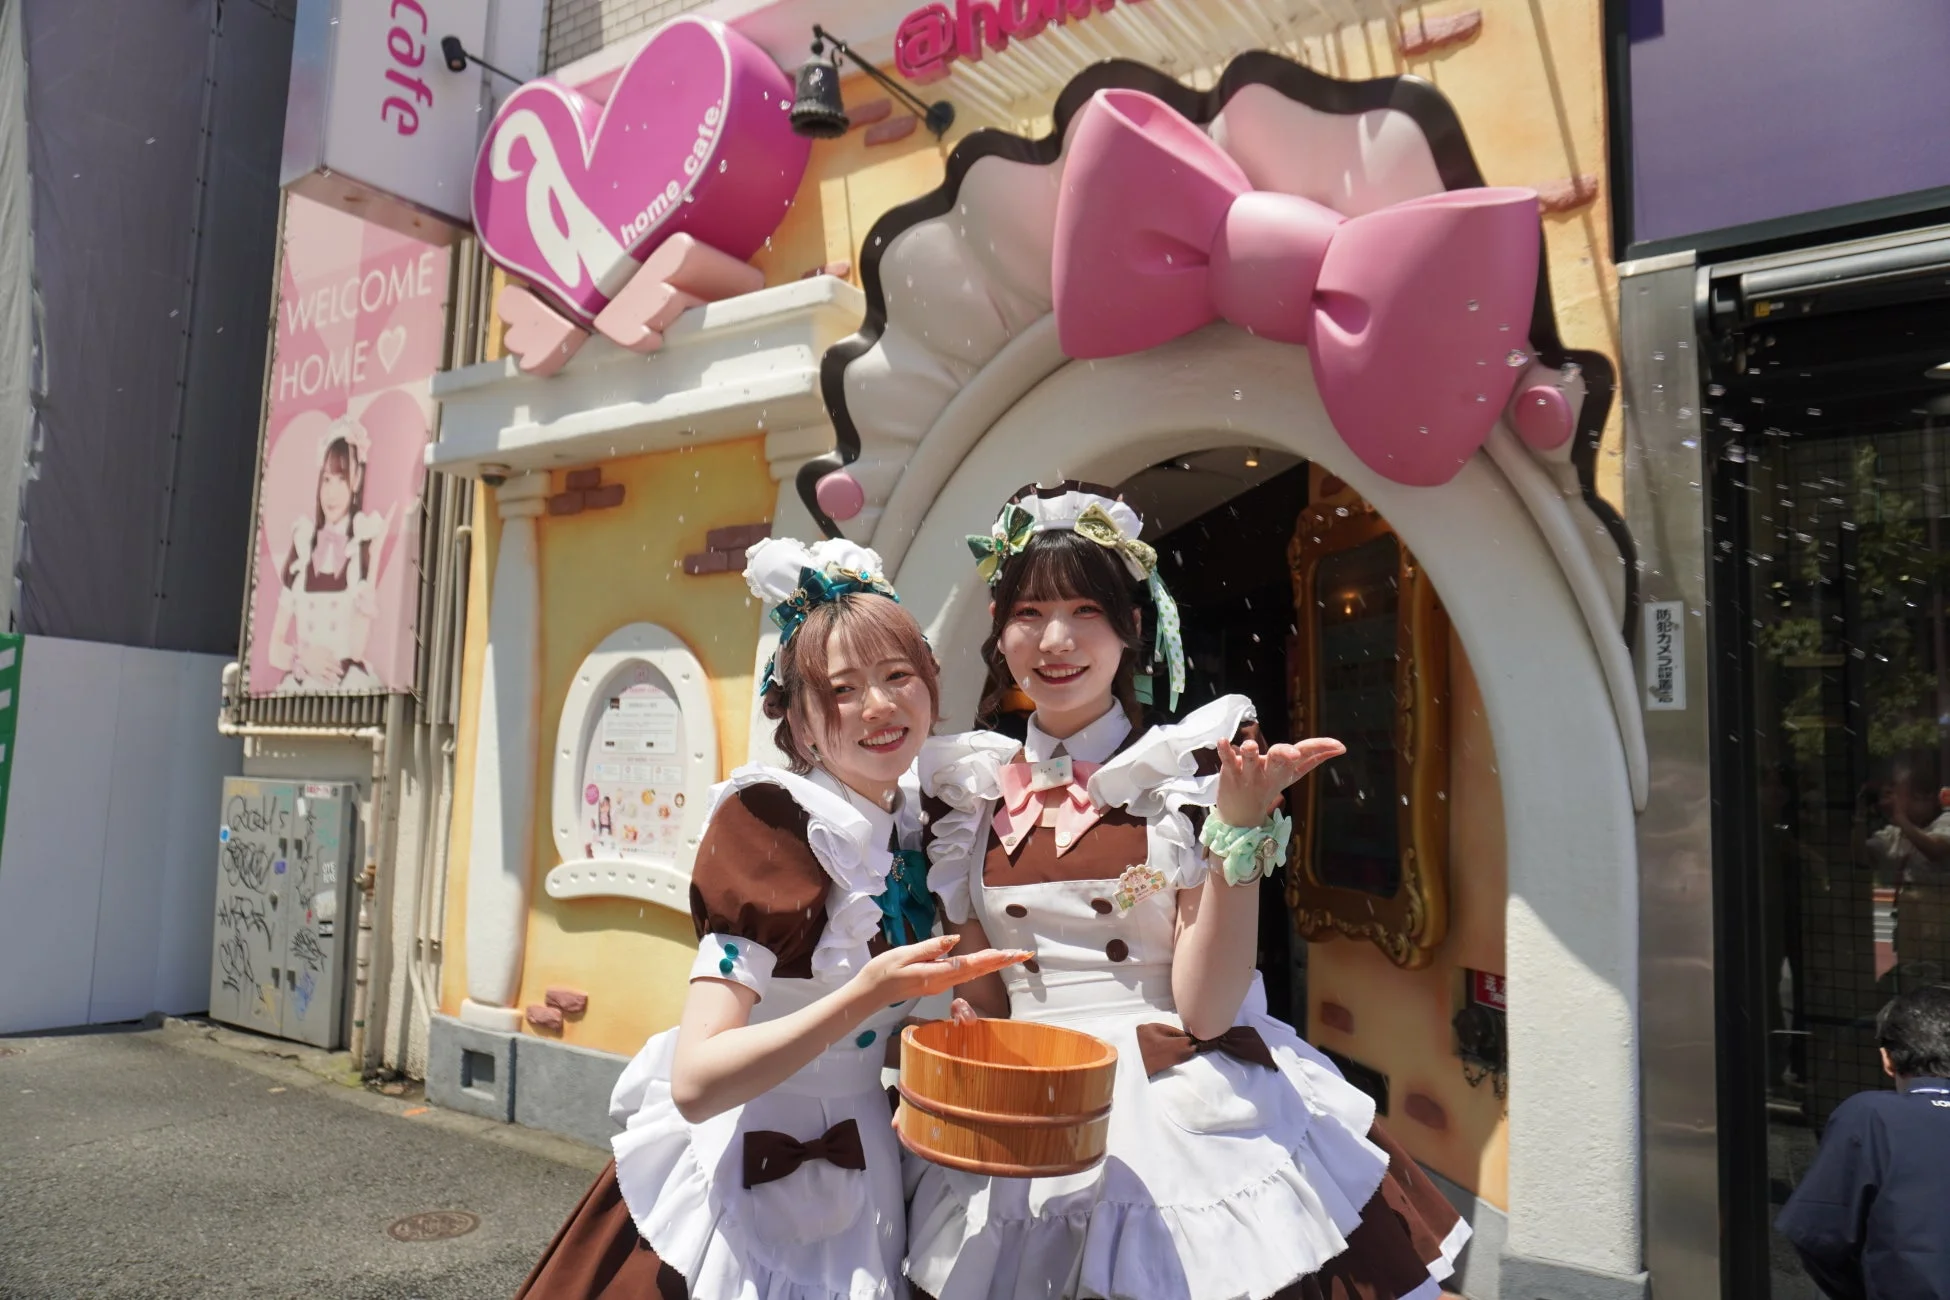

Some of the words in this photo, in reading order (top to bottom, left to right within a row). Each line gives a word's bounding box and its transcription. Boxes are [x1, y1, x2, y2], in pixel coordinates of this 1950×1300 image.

[381, 0, 433, 136] cafe
[894, 0, 1140, 85] @ho
[620, 180, 681, 246] home
[286, 251, 435, 336] WELCOME
[279, 339, 369, 401] HOME
